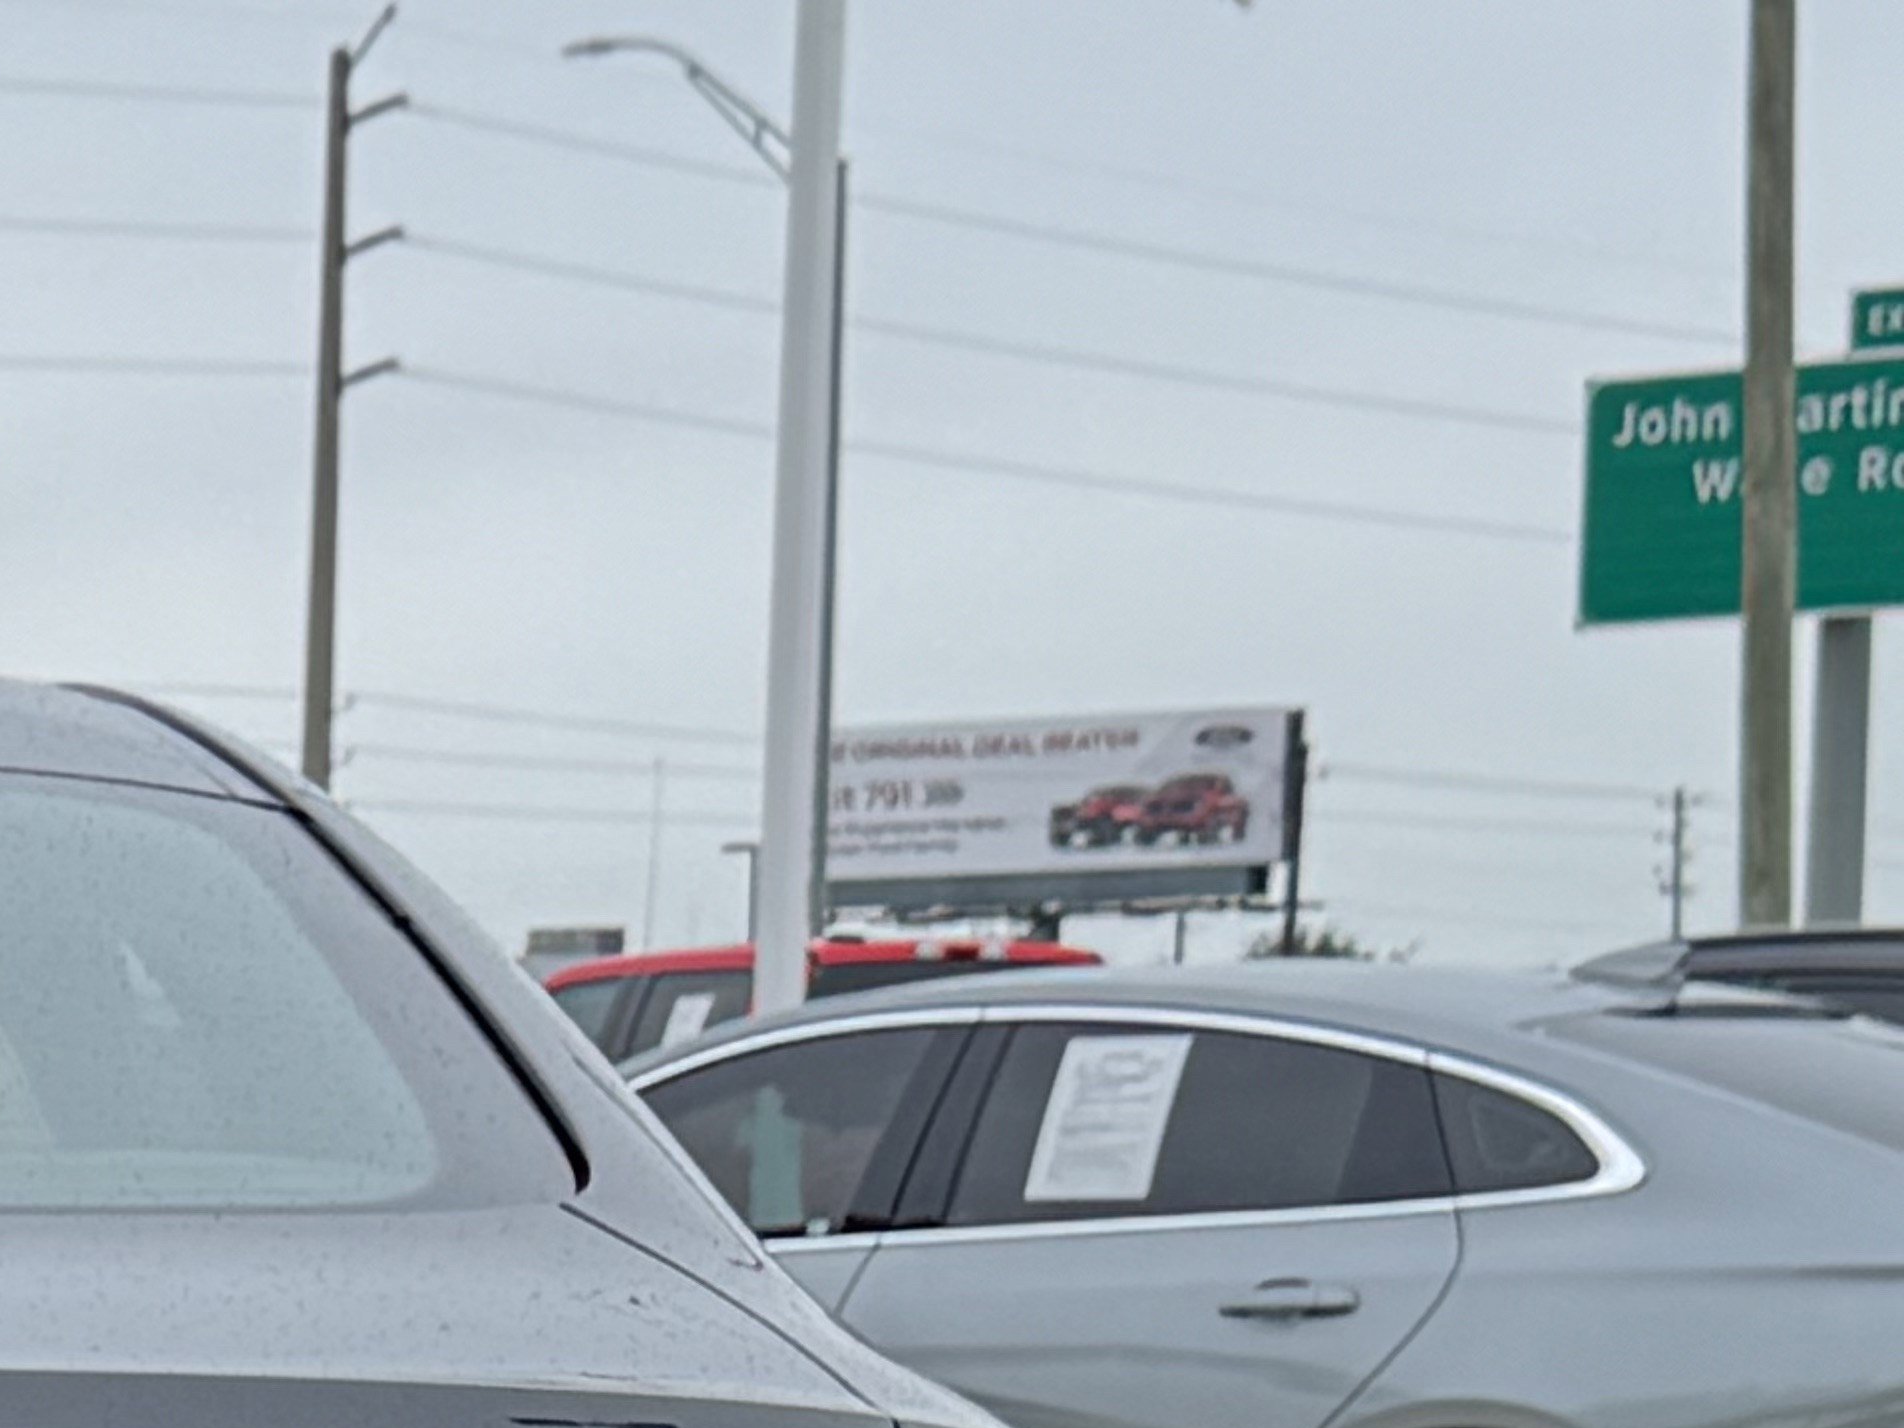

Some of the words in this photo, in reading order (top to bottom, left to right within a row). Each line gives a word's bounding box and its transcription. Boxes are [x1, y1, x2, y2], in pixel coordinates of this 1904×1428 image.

[1612, 396, 1733, 449] John
[1796, 376, 1904, 434] arti
[1692, 454, 1833, 504] We
